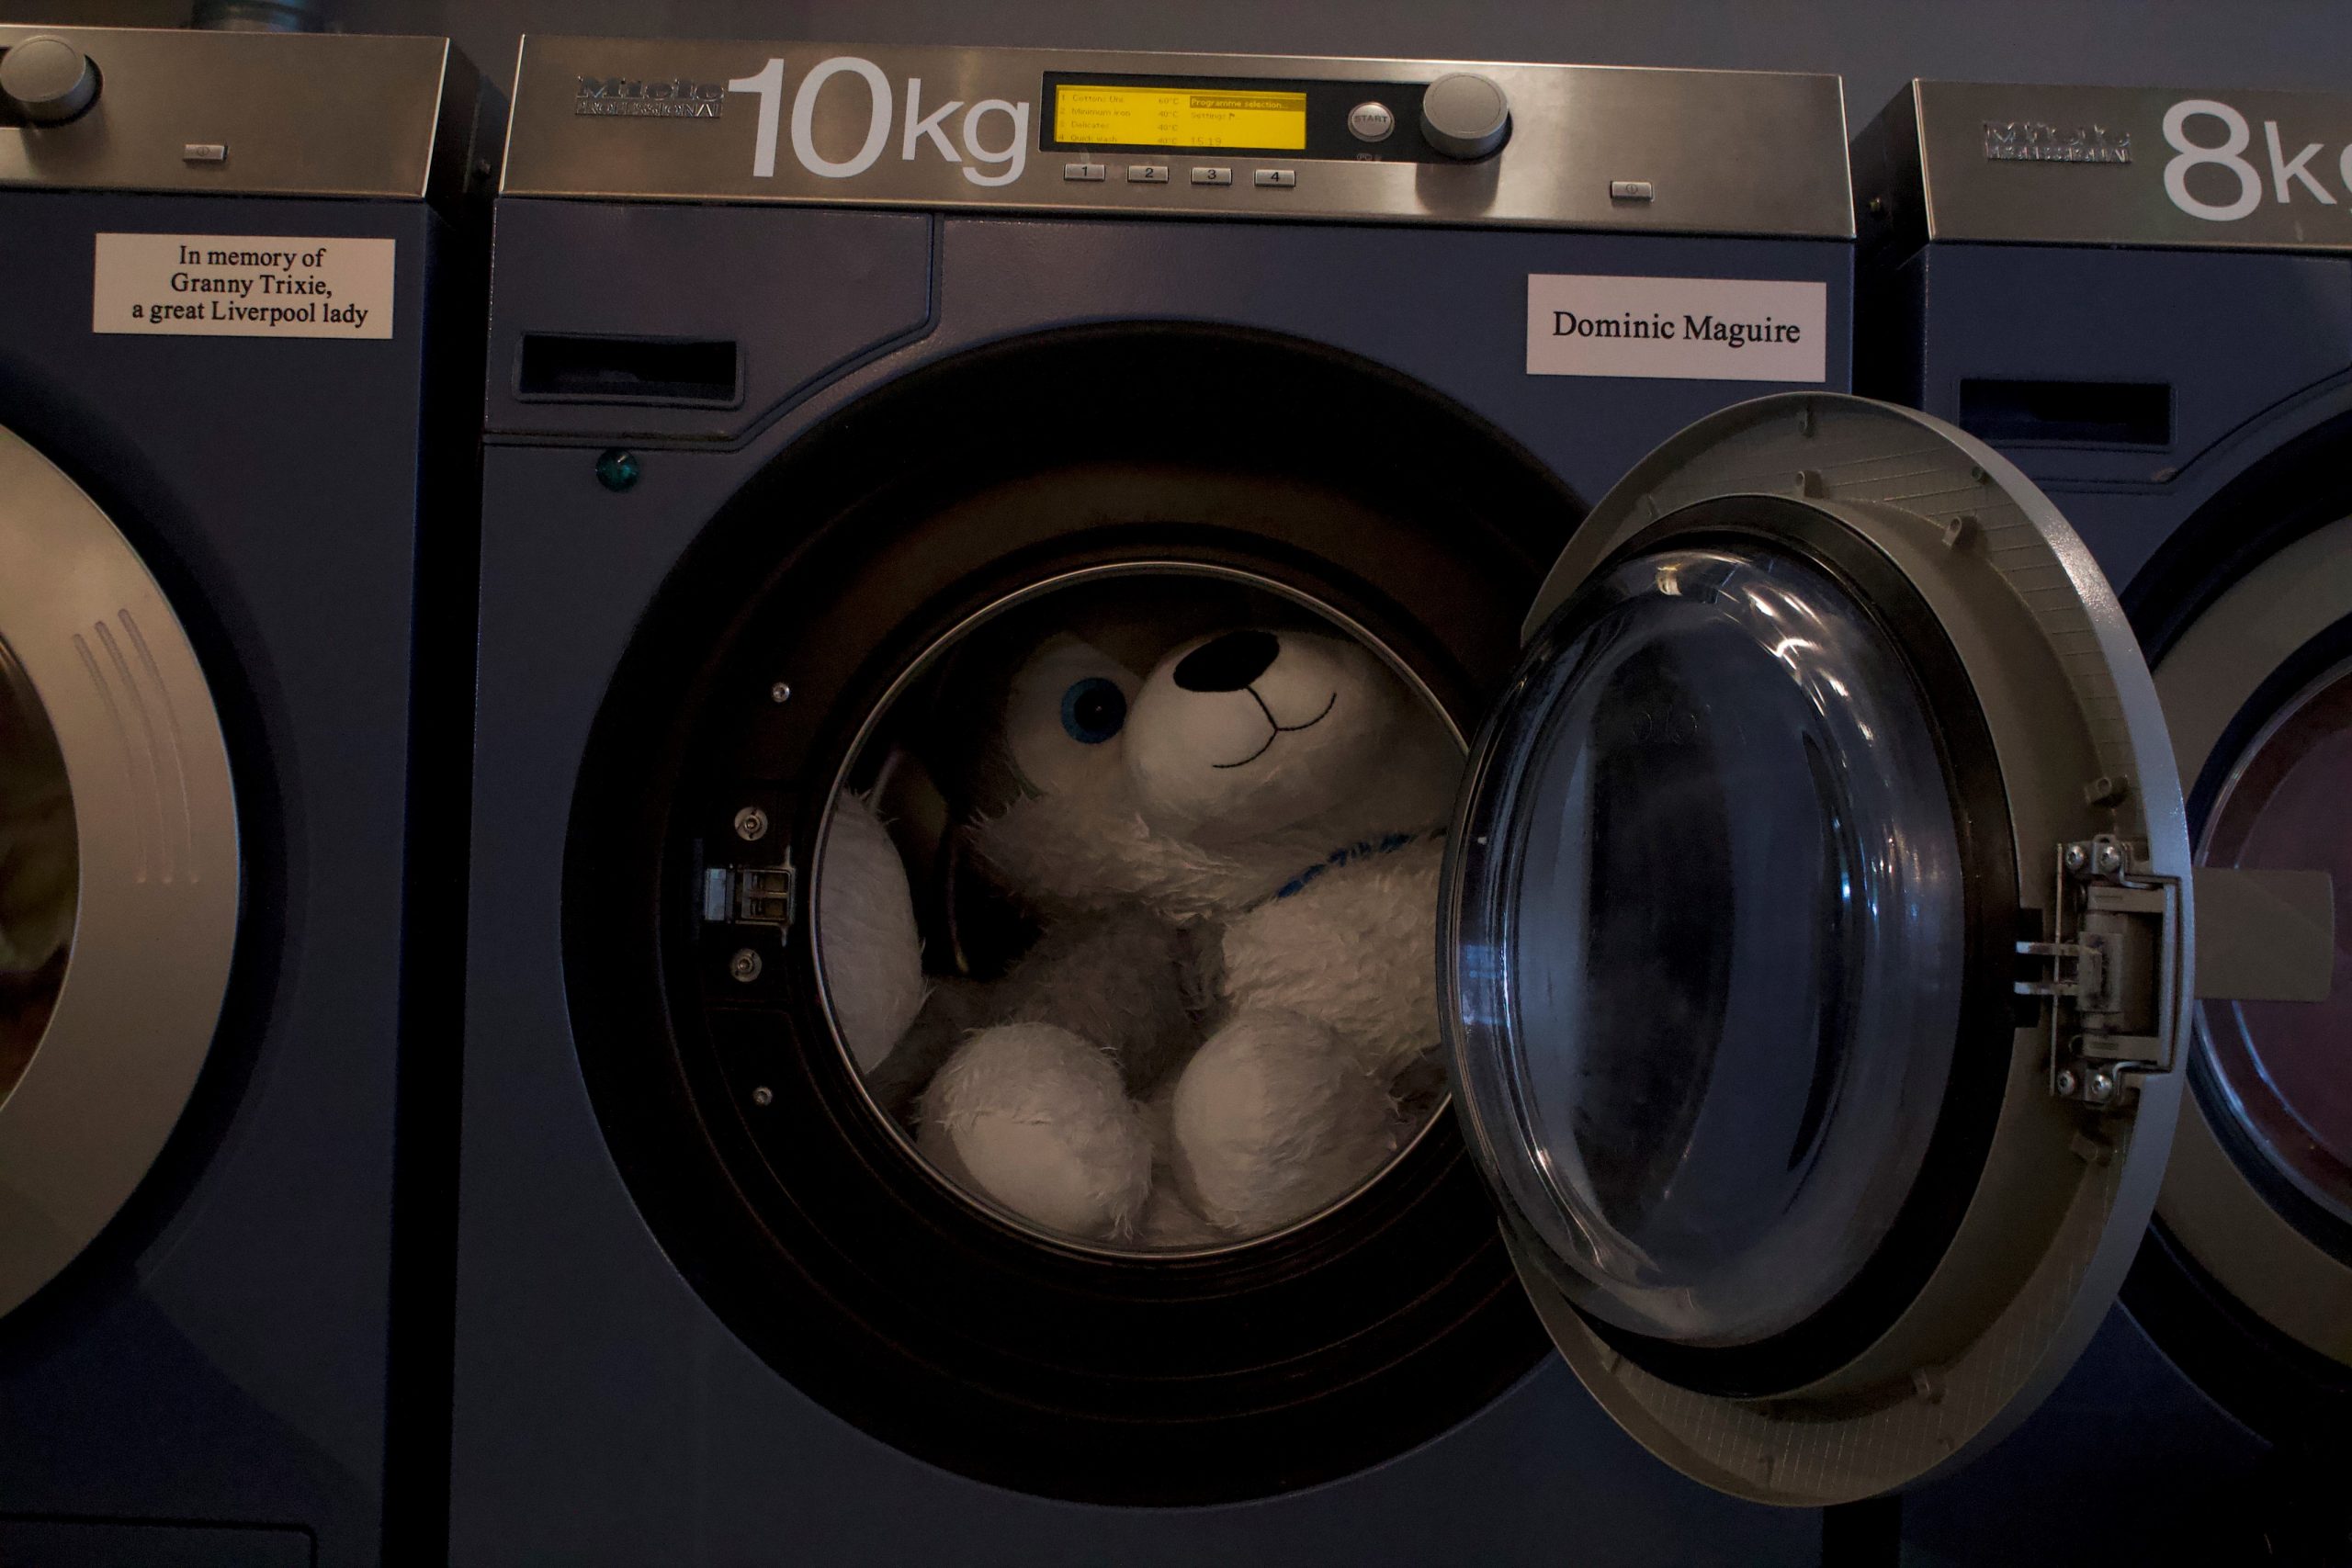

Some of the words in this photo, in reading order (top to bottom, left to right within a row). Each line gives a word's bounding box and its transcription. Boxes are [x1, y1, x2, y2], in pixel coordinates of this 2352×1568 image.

[1191, 97, 1242, 107] Programme
[2162, 99, 2352, 222] 8k
[1081, 166, 1088, 176] 1
[1145, 167, 1154, 178] 2
[1207, 169, 1217, 179] 3
[1271, 171, 1280, 182] 4
[179, 245, 201, 265] In
[208, 251, 297, 271] memory
[301, 248, 326, 267] of
[171, 273, 254, 298] Granny
[259, 275, 333, 297] Trixie,
[132, 305, 144, 318] a
[150, 304, 205, 323] great
[211, 301, 315, 326] Liverpool
[322, 304, 368, 328] lady
[1553, 310, 1675, 339] Dominic
[1683, 315, 1801, 348] Maguire
